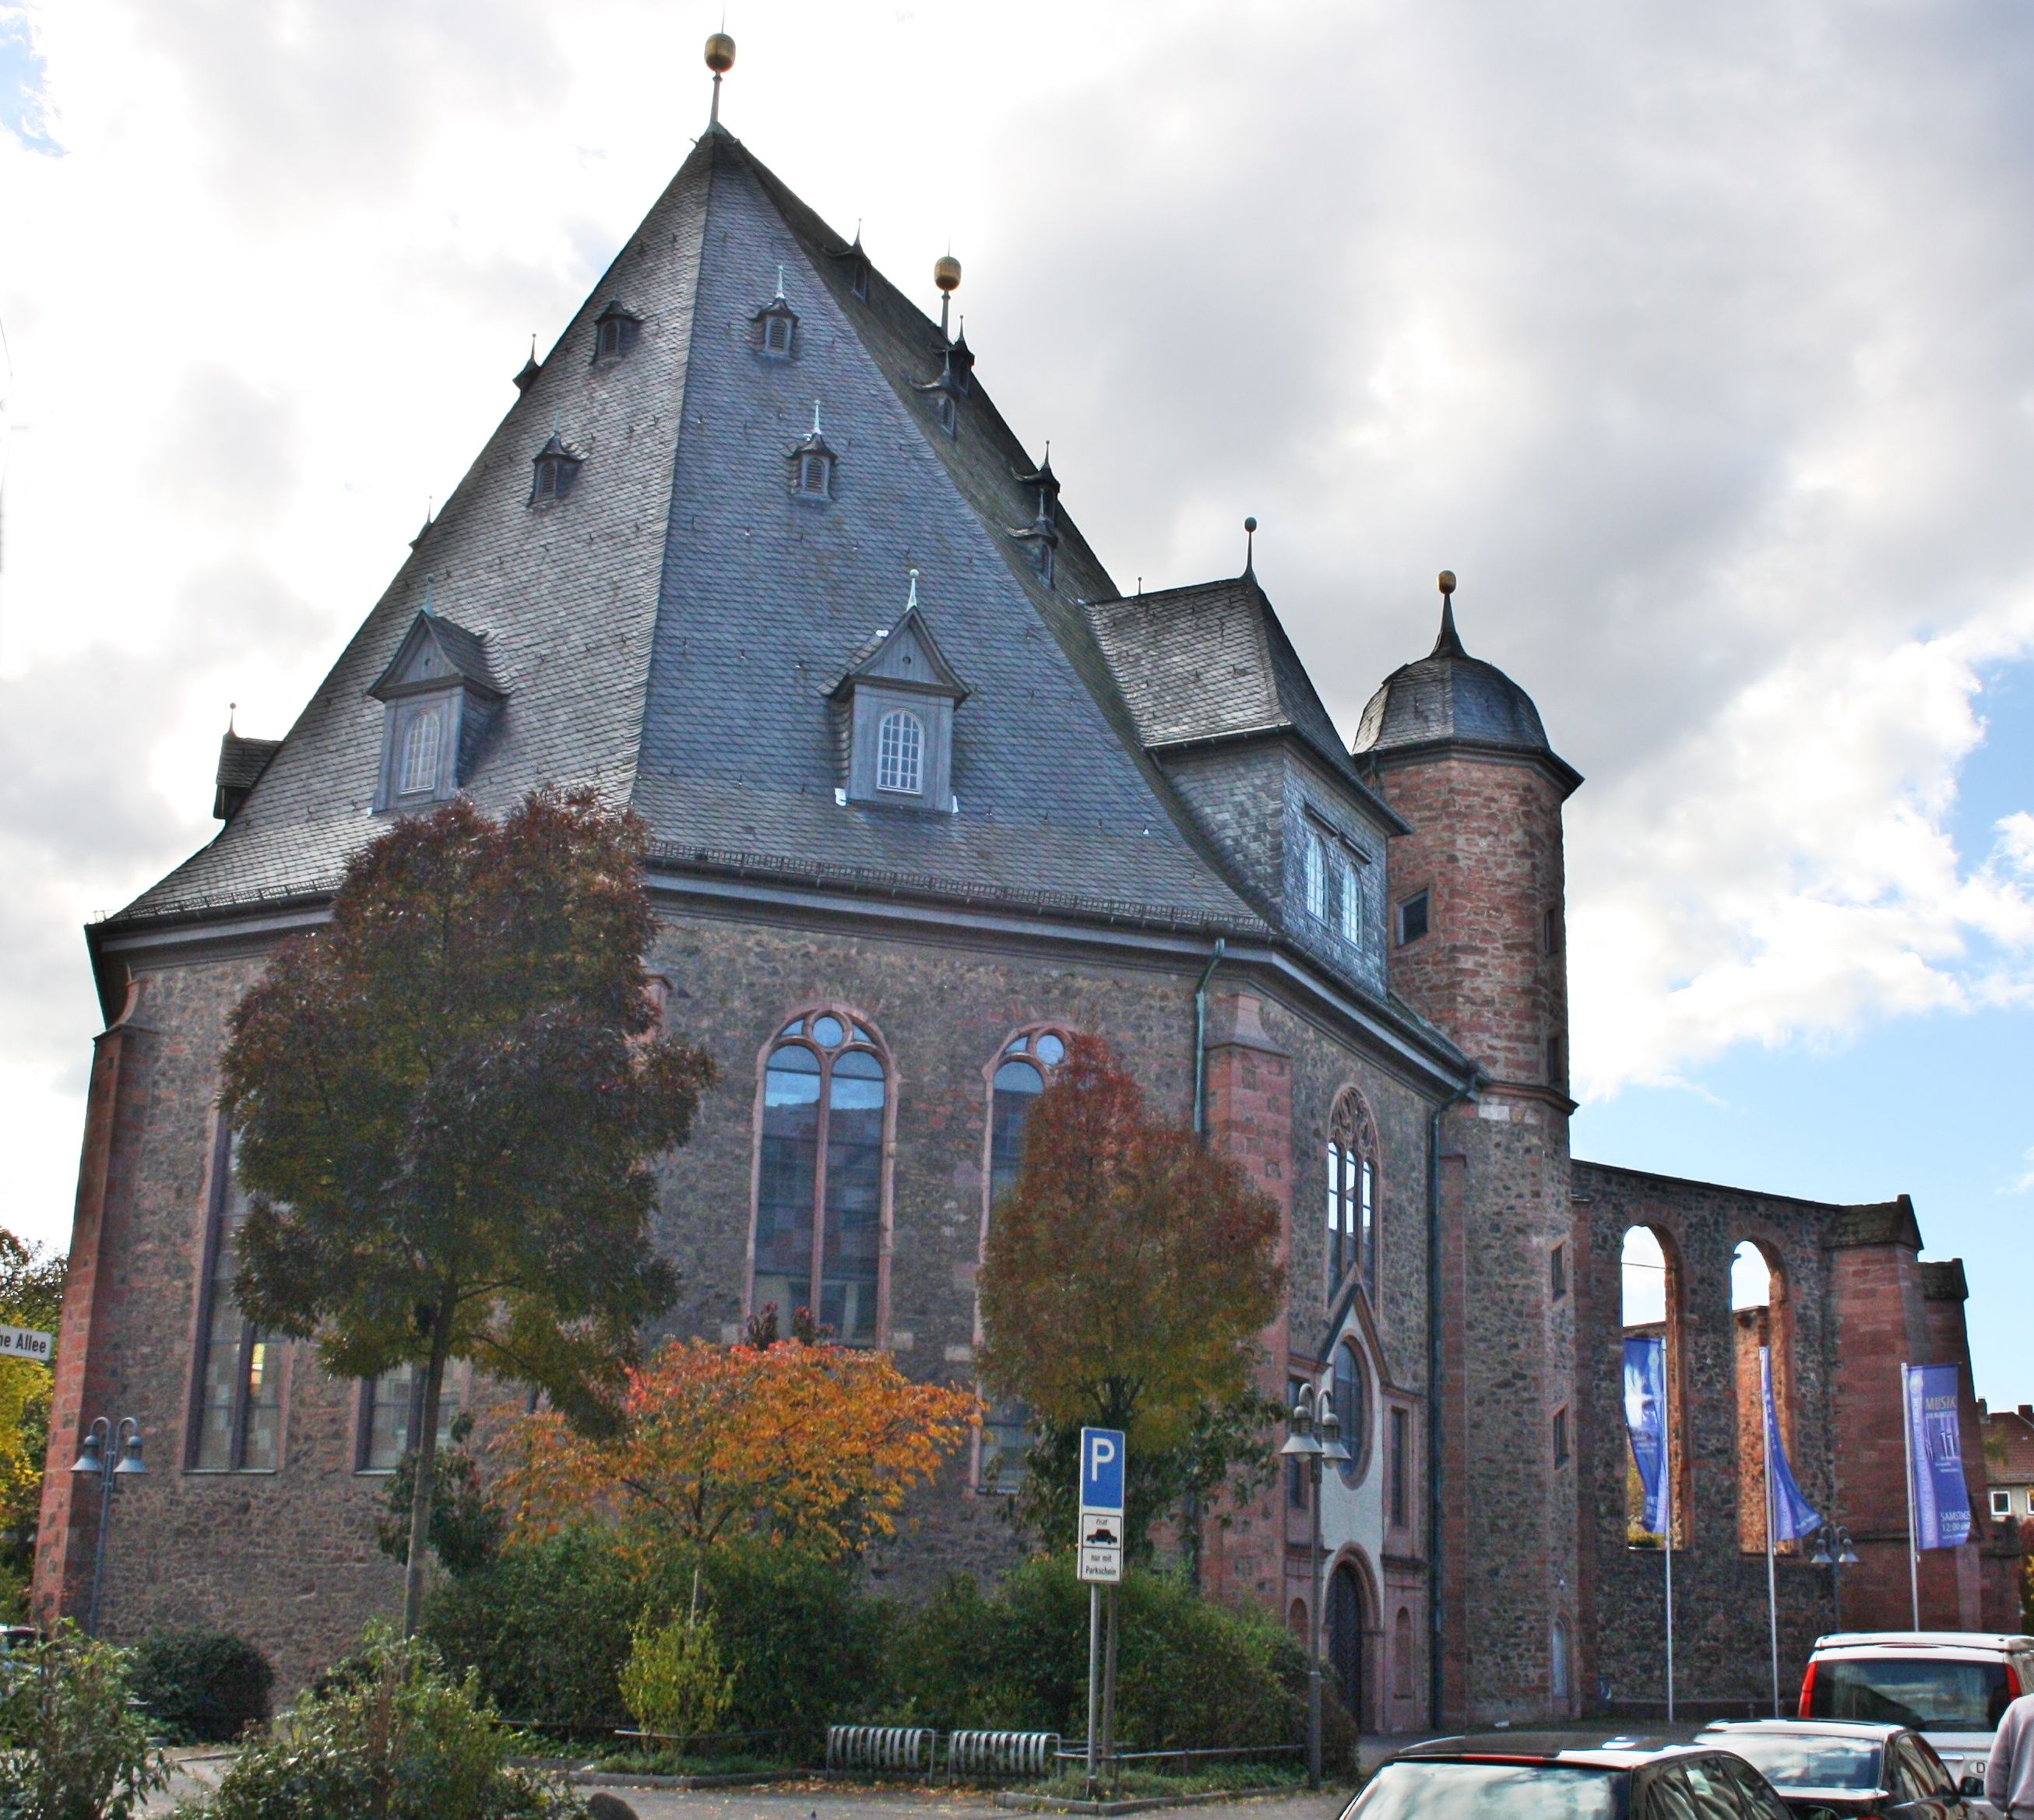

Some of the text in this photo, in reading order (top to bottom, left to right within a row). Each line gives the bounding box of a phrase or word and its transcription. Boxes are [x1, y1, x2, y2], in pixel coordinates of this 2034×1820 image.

[16, 1333, 47, 1353] Allee
[1926, 1396, 1956, 1409] MUSIK
[1092, 1437, 1114, 1481] P
[1102, 1554, 1111, 1562] mit
[1086, 1566, 1117, 1575] Parkschein
